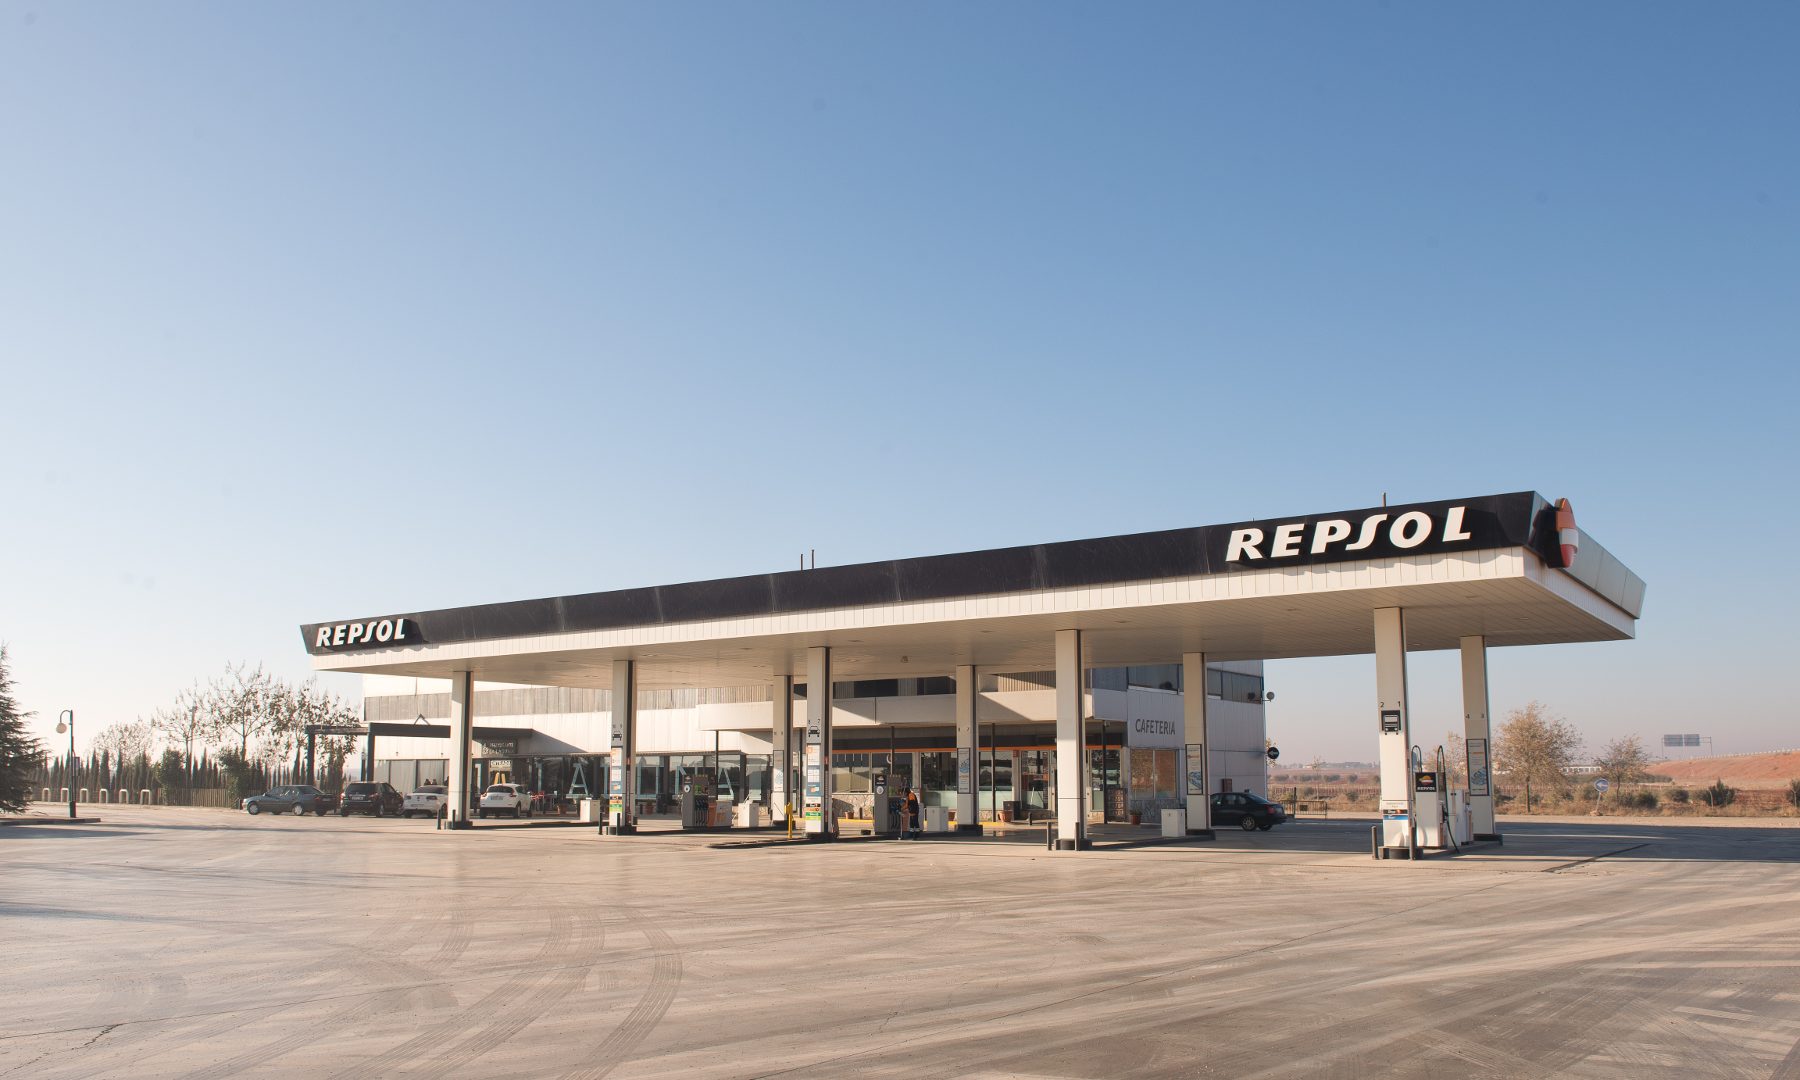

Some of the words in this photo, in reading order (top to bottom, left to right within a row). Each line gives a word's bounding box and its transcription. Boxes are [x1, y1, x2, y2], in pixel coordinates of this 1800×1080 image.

[1225, 506, 1471, 562] REPSOL
[315, 618, 405, 648] REPSOL
[1135, 718, 1176, 735] CAFETERIA
